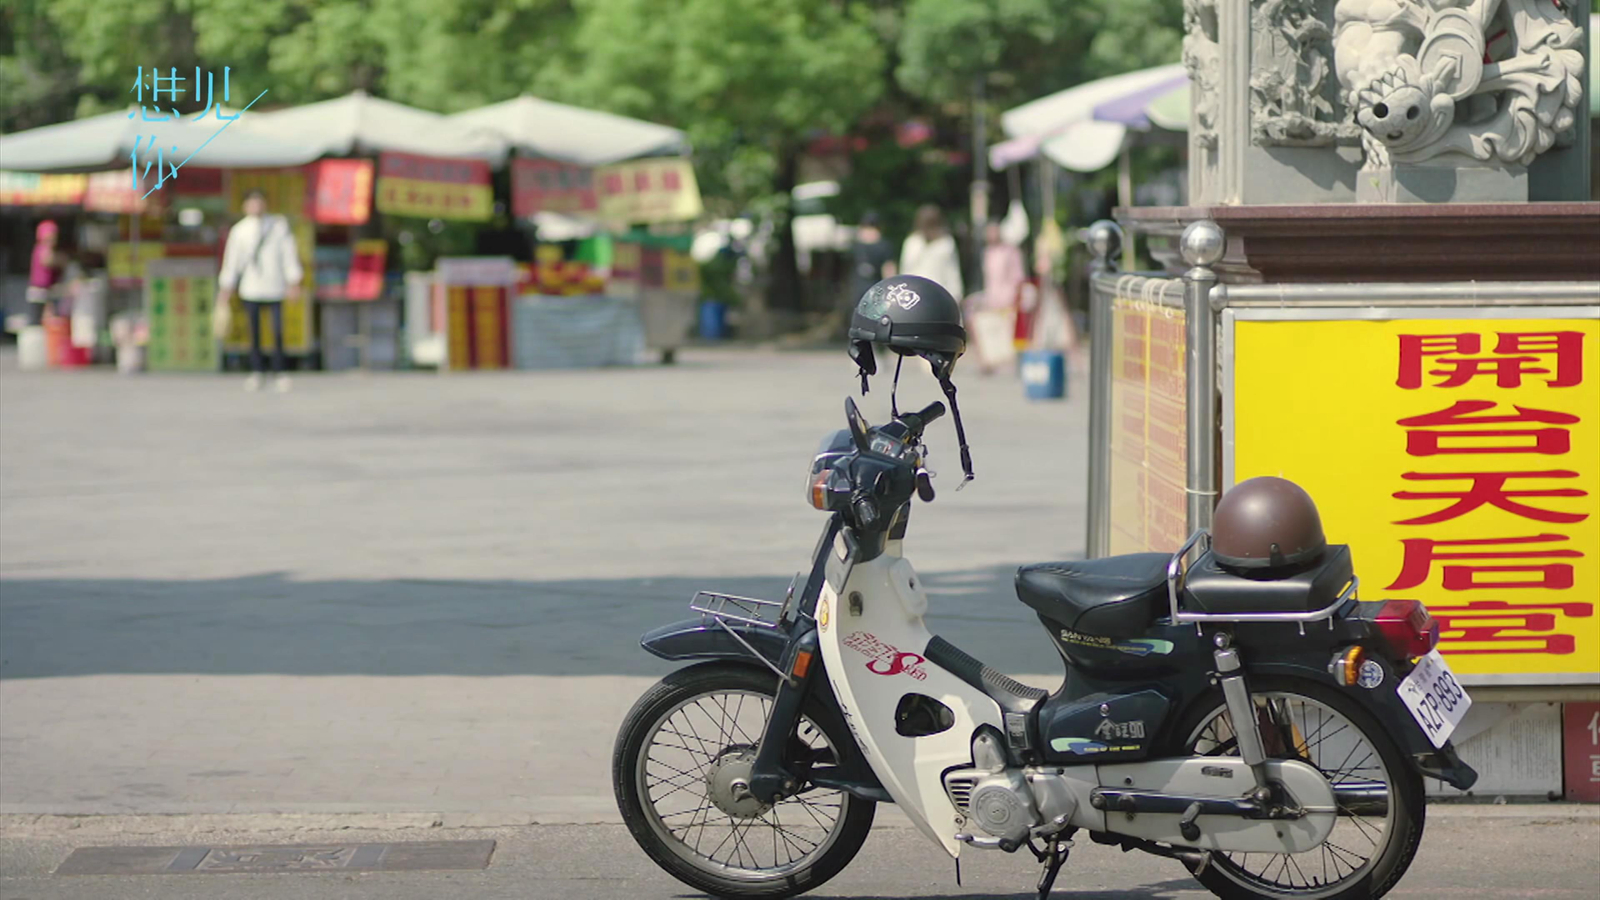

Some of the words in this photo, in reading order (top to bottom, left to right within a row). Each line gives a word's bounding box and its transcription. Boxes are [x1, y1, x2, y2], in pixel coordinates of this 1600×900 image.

[1382, 330, 1594, 655] 開台天后宮
